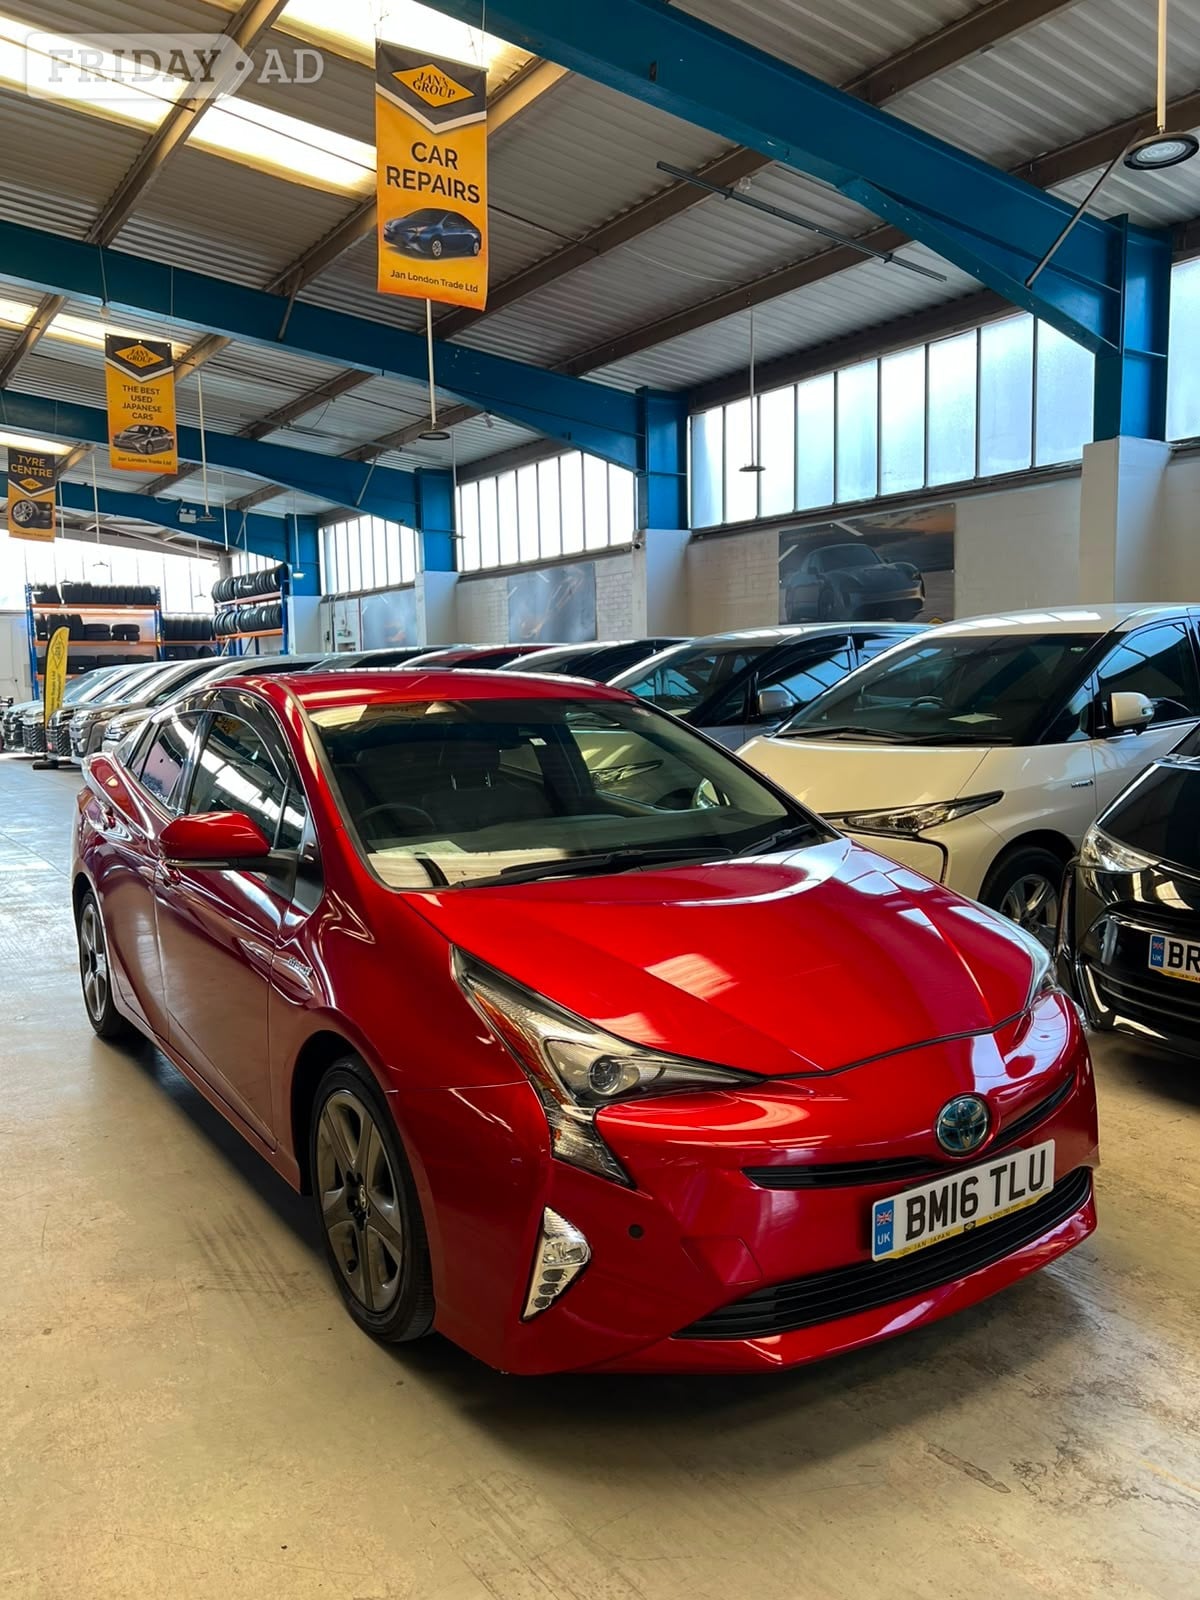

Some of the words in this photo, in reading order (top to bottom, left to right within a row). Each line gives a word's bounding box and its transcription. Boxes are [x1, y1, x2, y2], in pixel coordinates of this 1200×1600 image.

[417, 71, 449, 88] JAN'S
[412, 79, 456, 99] GROUP
[411, 141, 459, 171] CAR
[386, 165, 481, 204] REPAIRS
[390, 269, 406, 280] Jan
[407, 271, 440, 286] London
[440, 278, 464, 290] Trade
[465, 283, 479, 293] Ltd
[122, 384, 139, 394] THE
[140, 386, 160, 396] BEST
[130, 395, 153, 404] USED
[122, 402, 163, 414] JAPANESE
[131, 412, 154, 421] CARS
[17, 454, 46, 467] TYRE
[10, 463, 54, 478] CENTRE
[1168, 941, 1200, 974] BR
[905, 1176, 979, 1242] BM16
[989, 1149, 1046, 1207] TLU
[877, 1231, 892, 1246] UK
